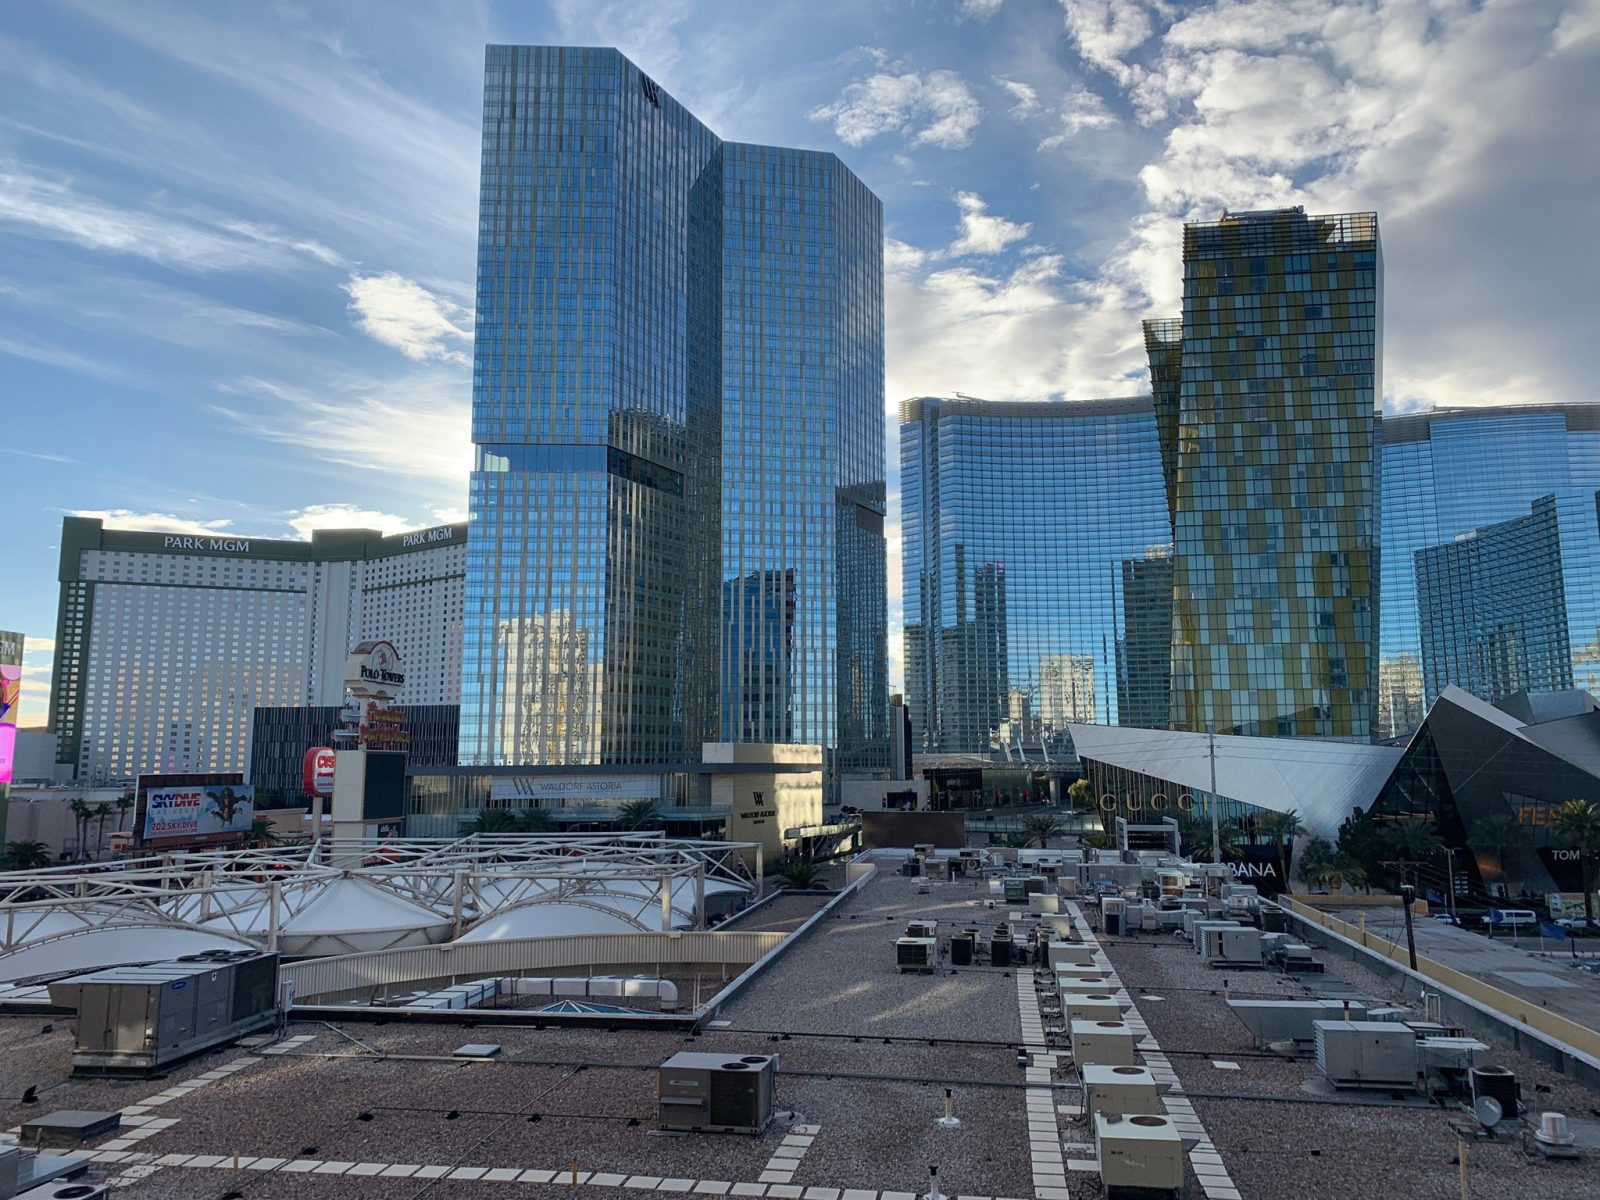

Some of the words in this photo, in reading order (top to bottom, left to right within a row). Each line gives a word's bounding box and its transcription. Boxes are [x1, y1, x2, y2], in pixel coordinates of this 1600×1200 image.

[164, 536, 204, 549] PARK
[209, 539, 249, 552] MGM
[402, 532, 426, 547] PARK
[428, 527, 452, 542] MGM
[317, 755, 336, 769] CVS
[540, 783, 585, 791] WALDORF
[586, 781, 623, 791] ASTORIA
[151, 792, 201, 809] SKYDIVE
[1100, 792, 1208, 812] GUCCI
[1552, 849, 1580, 861] TOM
